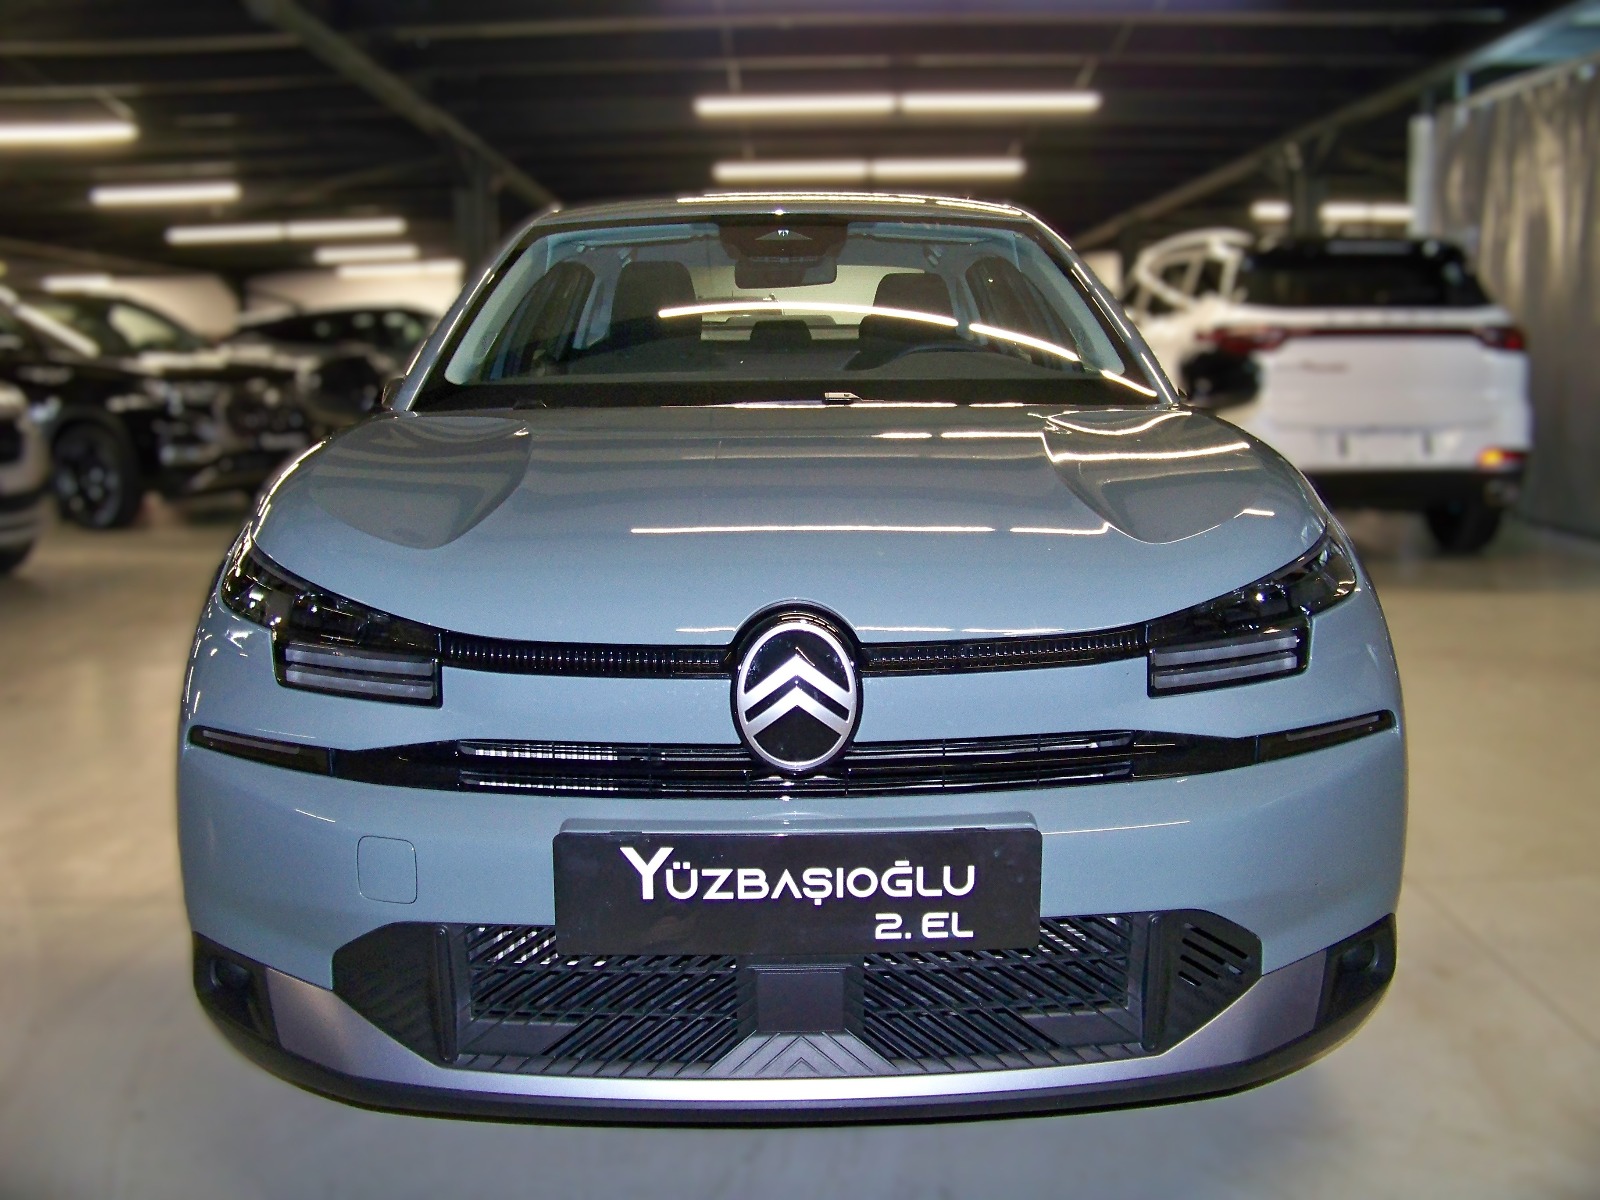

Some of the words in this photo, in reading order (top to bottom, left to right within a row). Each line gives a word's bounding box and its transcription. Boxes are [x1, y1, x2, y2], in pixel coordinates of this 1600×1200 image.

[619, 846, 976, 906] YÜZBAŞIOĞLU
[874, 912, 912, 940] 2.
[921, 911, 974, 939] EL
